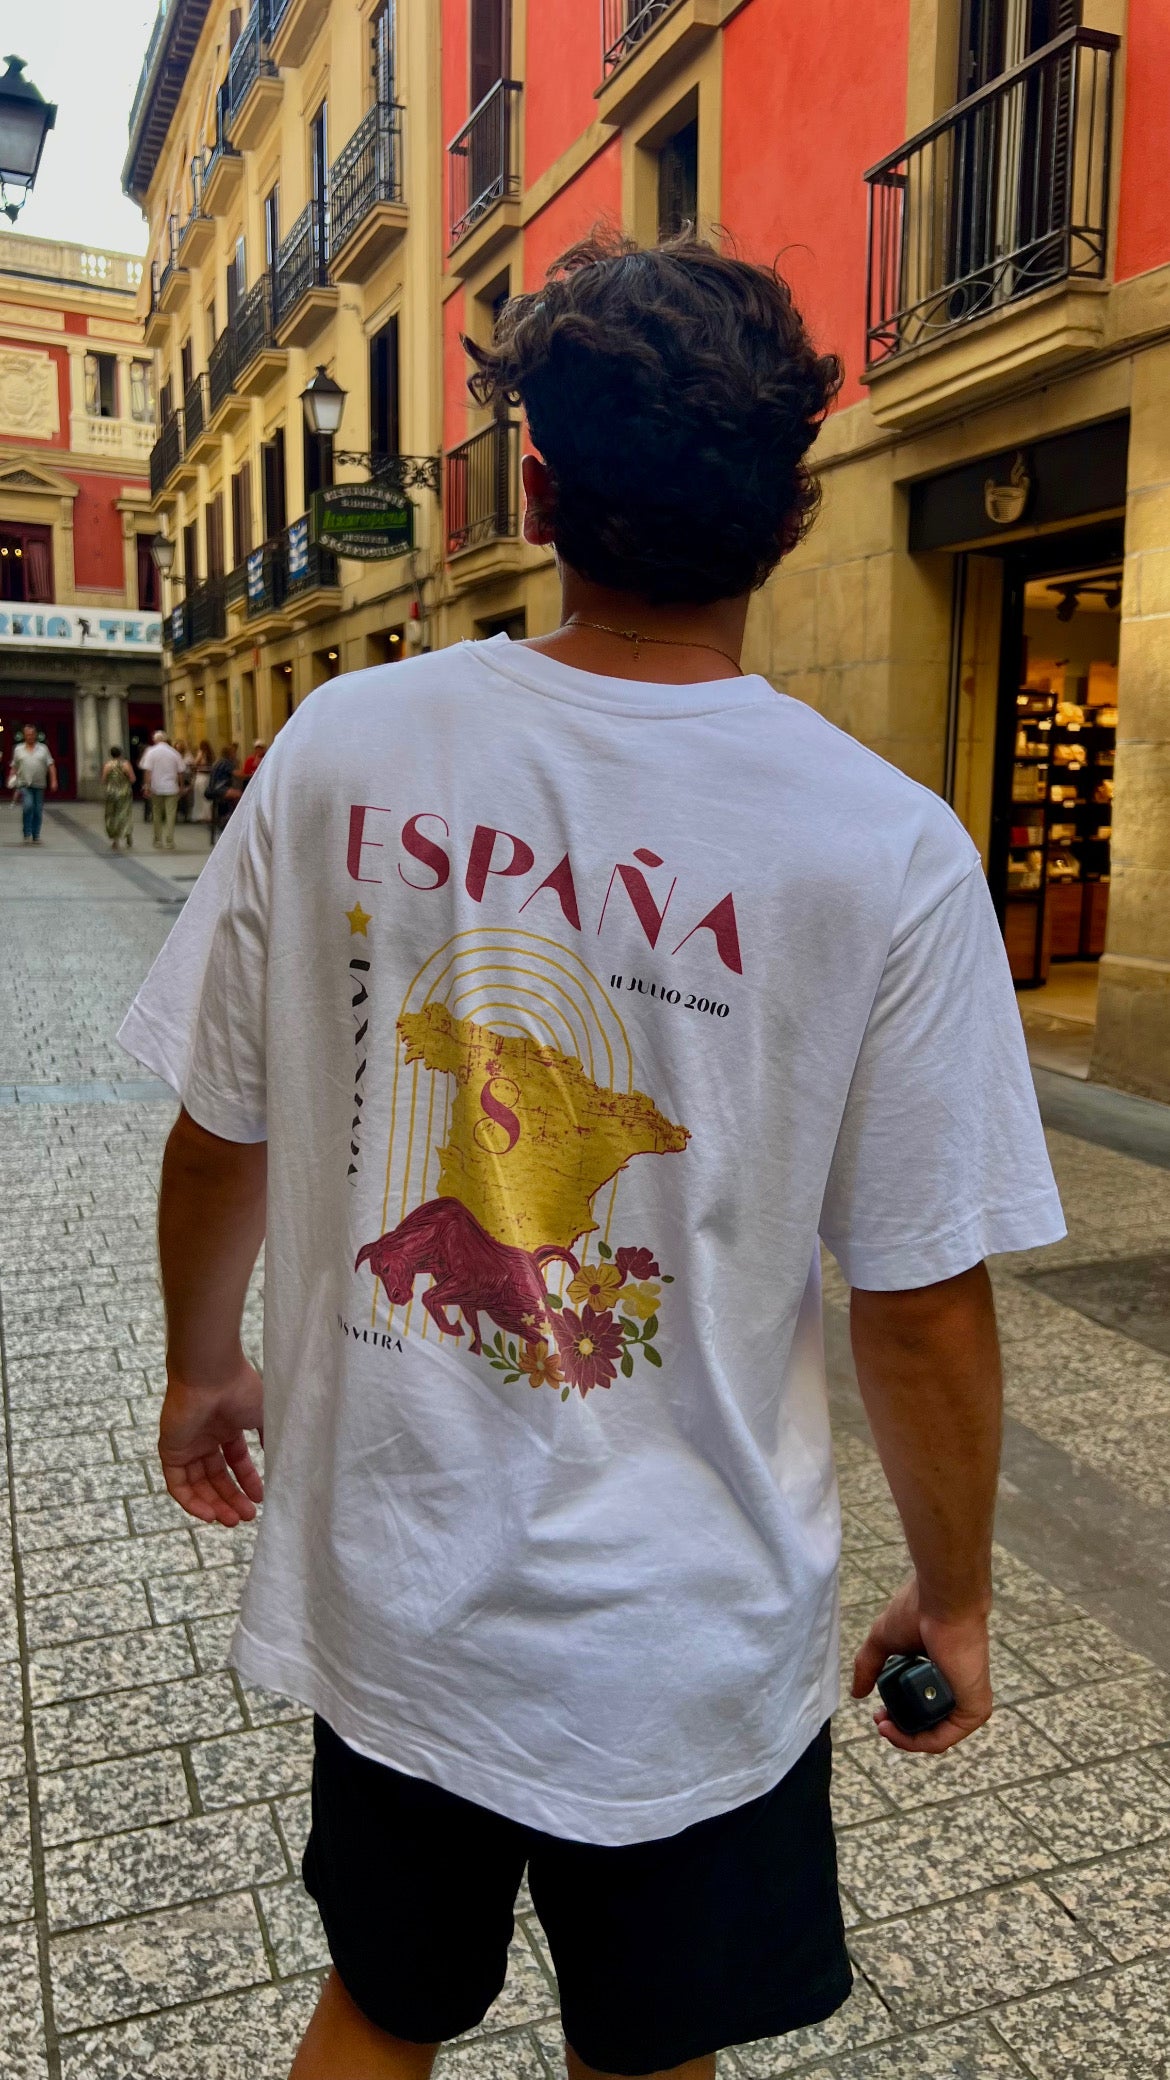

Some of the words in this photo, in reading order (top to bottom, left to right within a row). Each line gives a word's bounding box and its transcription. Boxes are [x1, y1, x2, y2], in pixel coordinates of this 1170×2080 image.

[347, 805, 743, 975] ESPAÑA
[626, 977, 681, 1004] JULIO
[684, 994, 730, 1018] 2010
